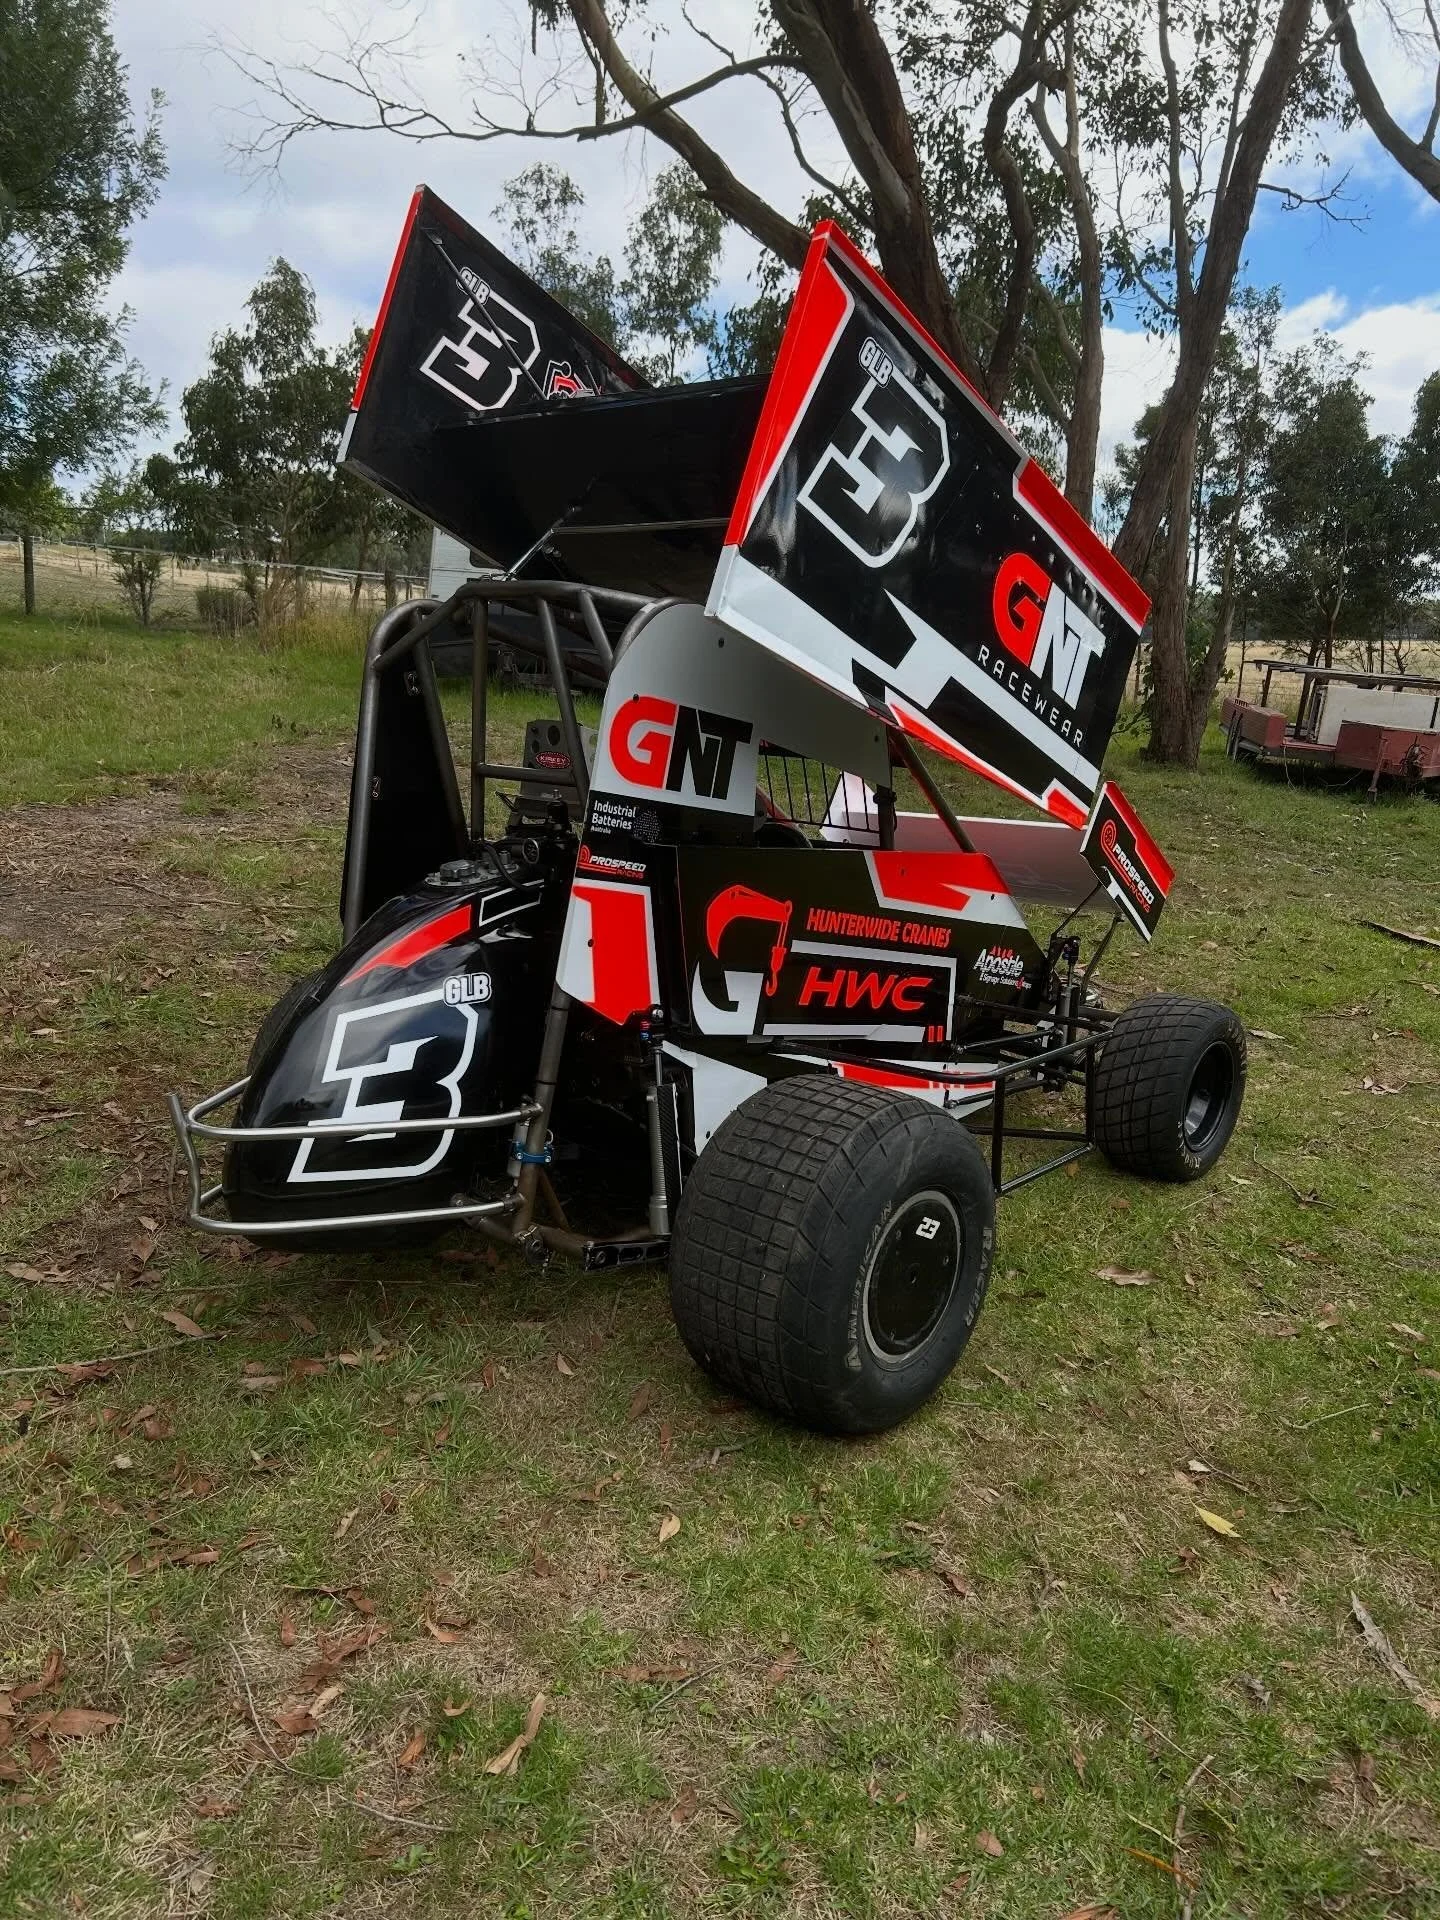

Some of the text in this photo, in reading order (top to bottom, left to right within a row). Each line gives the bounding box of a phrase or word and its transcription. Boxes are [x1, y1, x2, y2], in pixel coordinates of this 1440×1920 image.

[419, 291, 541, 411] 3
[858, 337, 895, 388] GLB
[796, 370, 951, 568] 3
[993, 553, 1106, 709] GNT
[977, 645, 1083, 747] RACEWEAR
[609, 695, 753, 800] GNT
[592, 813, 632, 830] Batteries
[594, 800, 636, 818] Industrial
[589, 855, 647, 872] PROSPEED
[1113, 844, 1155, 905] PROSPEED
[1129, 881, 1150, 913] RACING
[806, 907, 952, 949] HUNTERWIDE CRANES
[973, 948, 1024, 977] Apostle
[443, 972, 492, 1006] GLB
[798, 966, 933, 1011] HWC
[286, 988, 479, 1183] 3
[916, 1216, 941, 1240] 23
